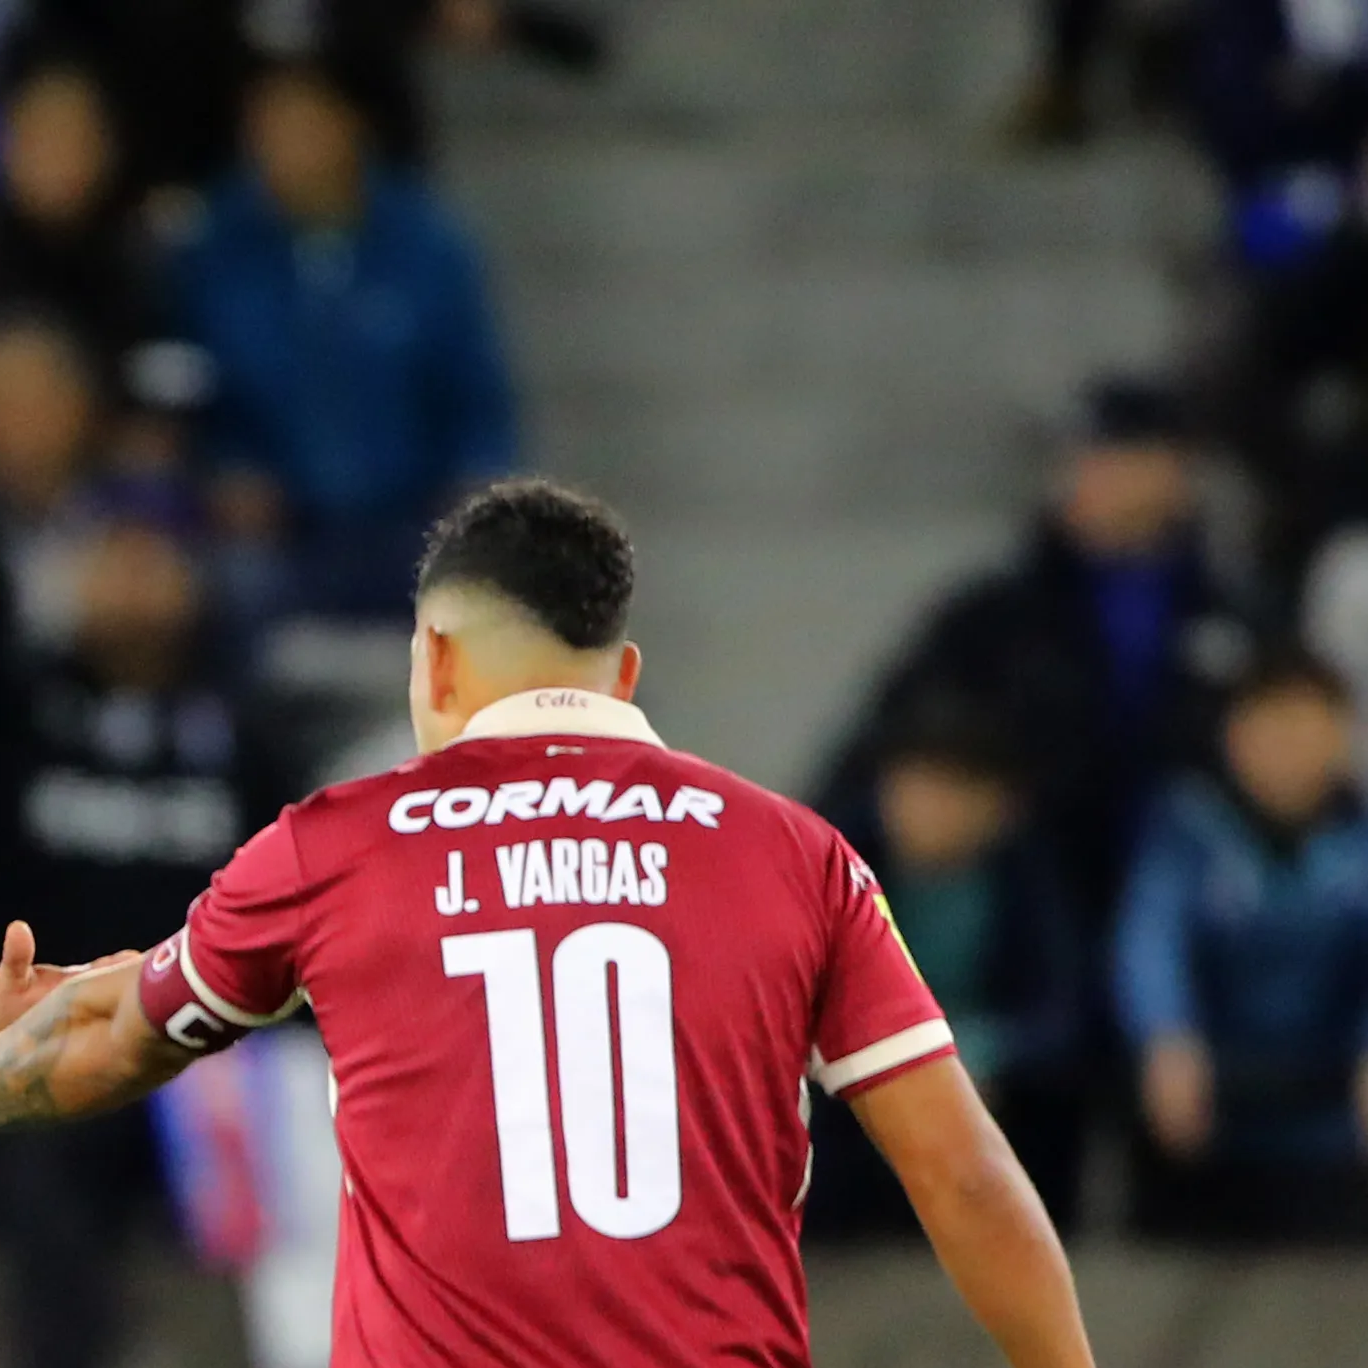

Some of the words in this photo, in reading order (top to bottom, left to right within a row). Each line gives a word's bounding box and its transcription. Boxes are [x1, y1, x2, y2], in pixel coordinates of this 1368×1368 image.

[388, 776, 725, 834] CORMAR
[434, 850, 481, 916] J.
[495, 838, 669, 909] VARGAS
[440, 921, 683, 1243] 10
